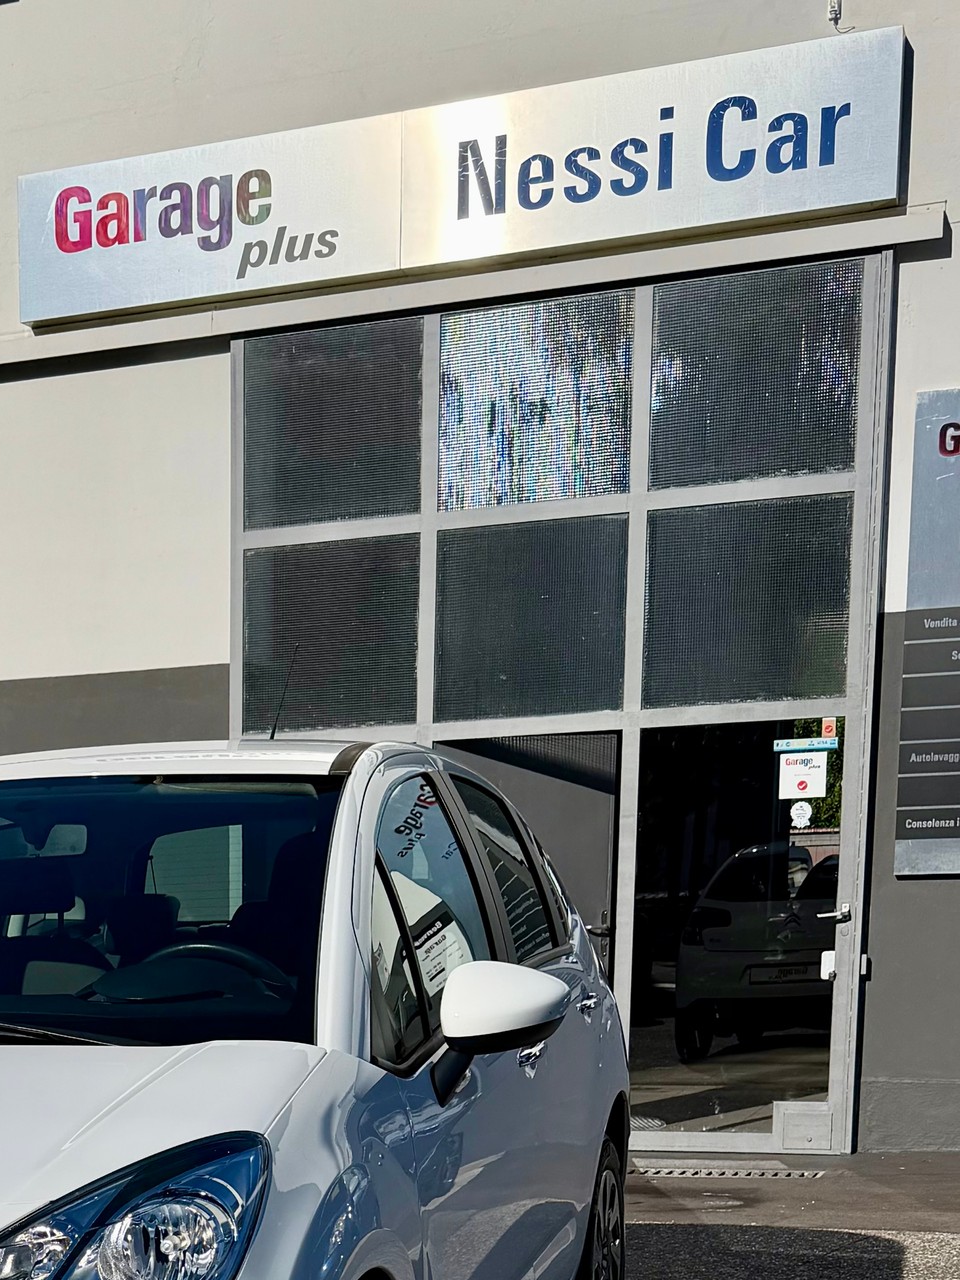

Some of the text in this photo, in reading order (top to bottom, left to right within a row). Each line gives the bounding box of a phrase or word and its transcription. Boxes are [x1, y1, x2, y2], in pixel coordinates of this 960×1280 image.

[457, 95, 851, 220] Nessi Car
[54, 168, 273, 254] Garage
[236, 226, 340, 280] plus
[924, 617, 958, 629] Vendita
[785, 758, 813, 767] Garage
